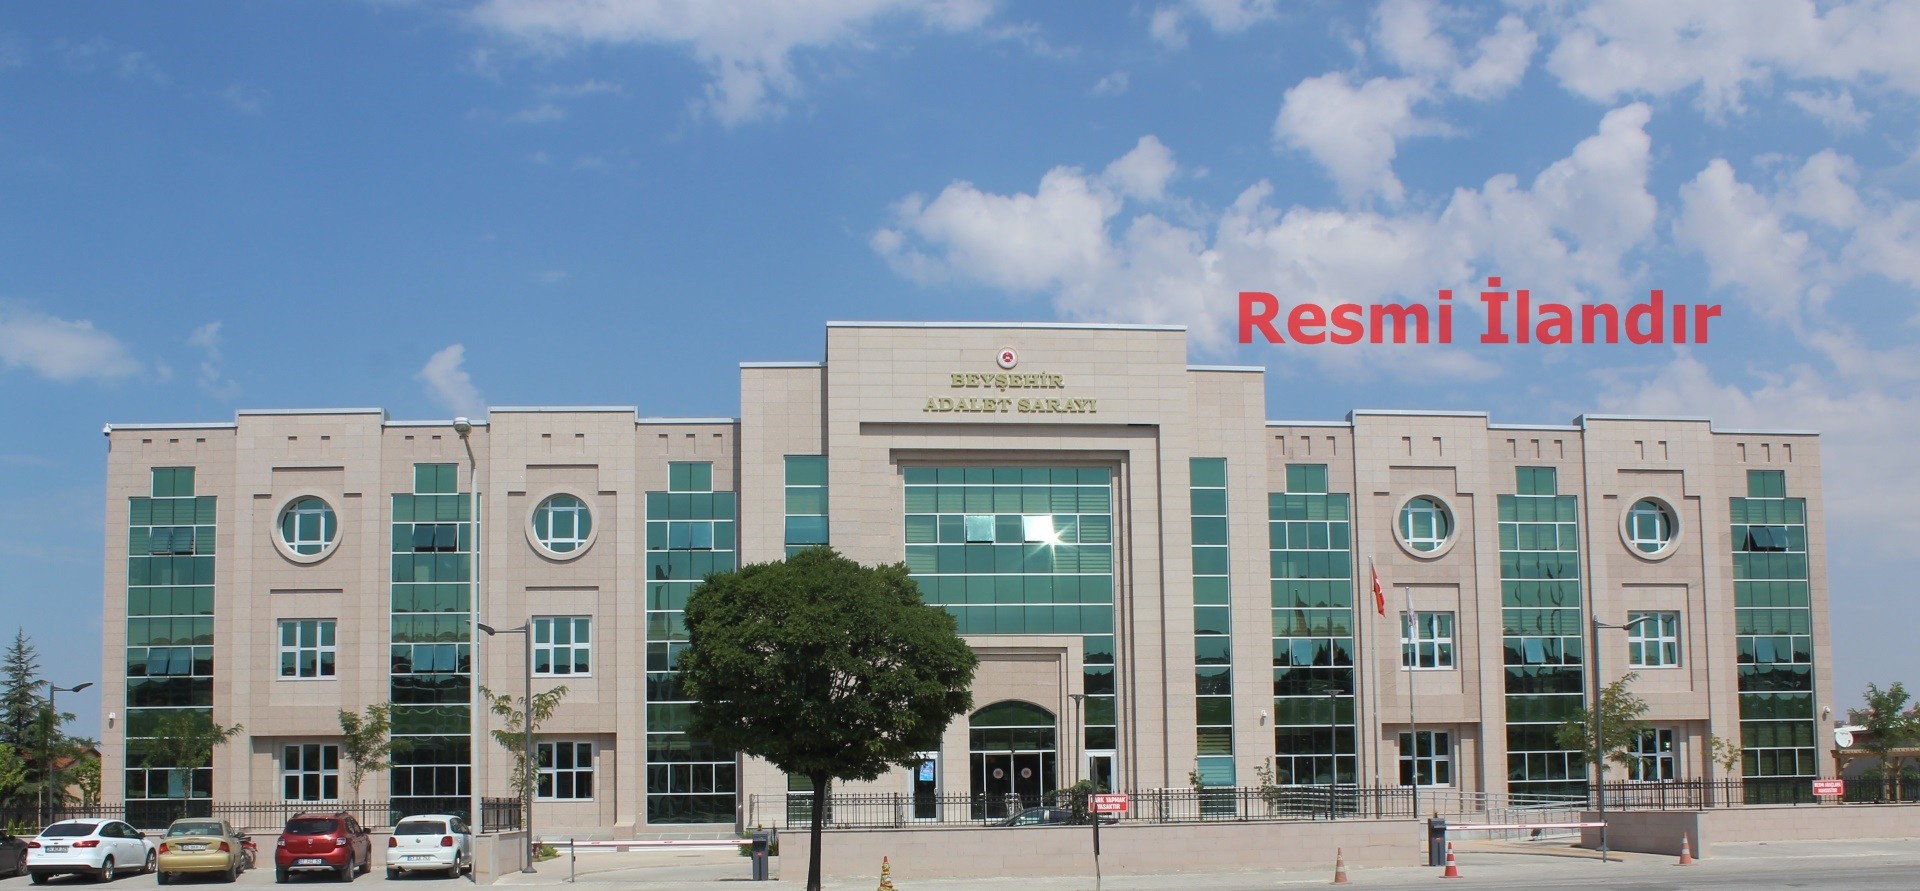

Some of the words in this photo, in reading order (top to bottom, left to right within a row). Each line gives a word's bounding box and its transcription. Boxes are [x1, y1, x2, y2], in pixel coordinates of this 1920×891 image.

[950, 371, 1065, 392] BEYŞEHİR
[923, 396, 1012, 412] ADALET
[1017, 397, 1097, 413] SARAYI
